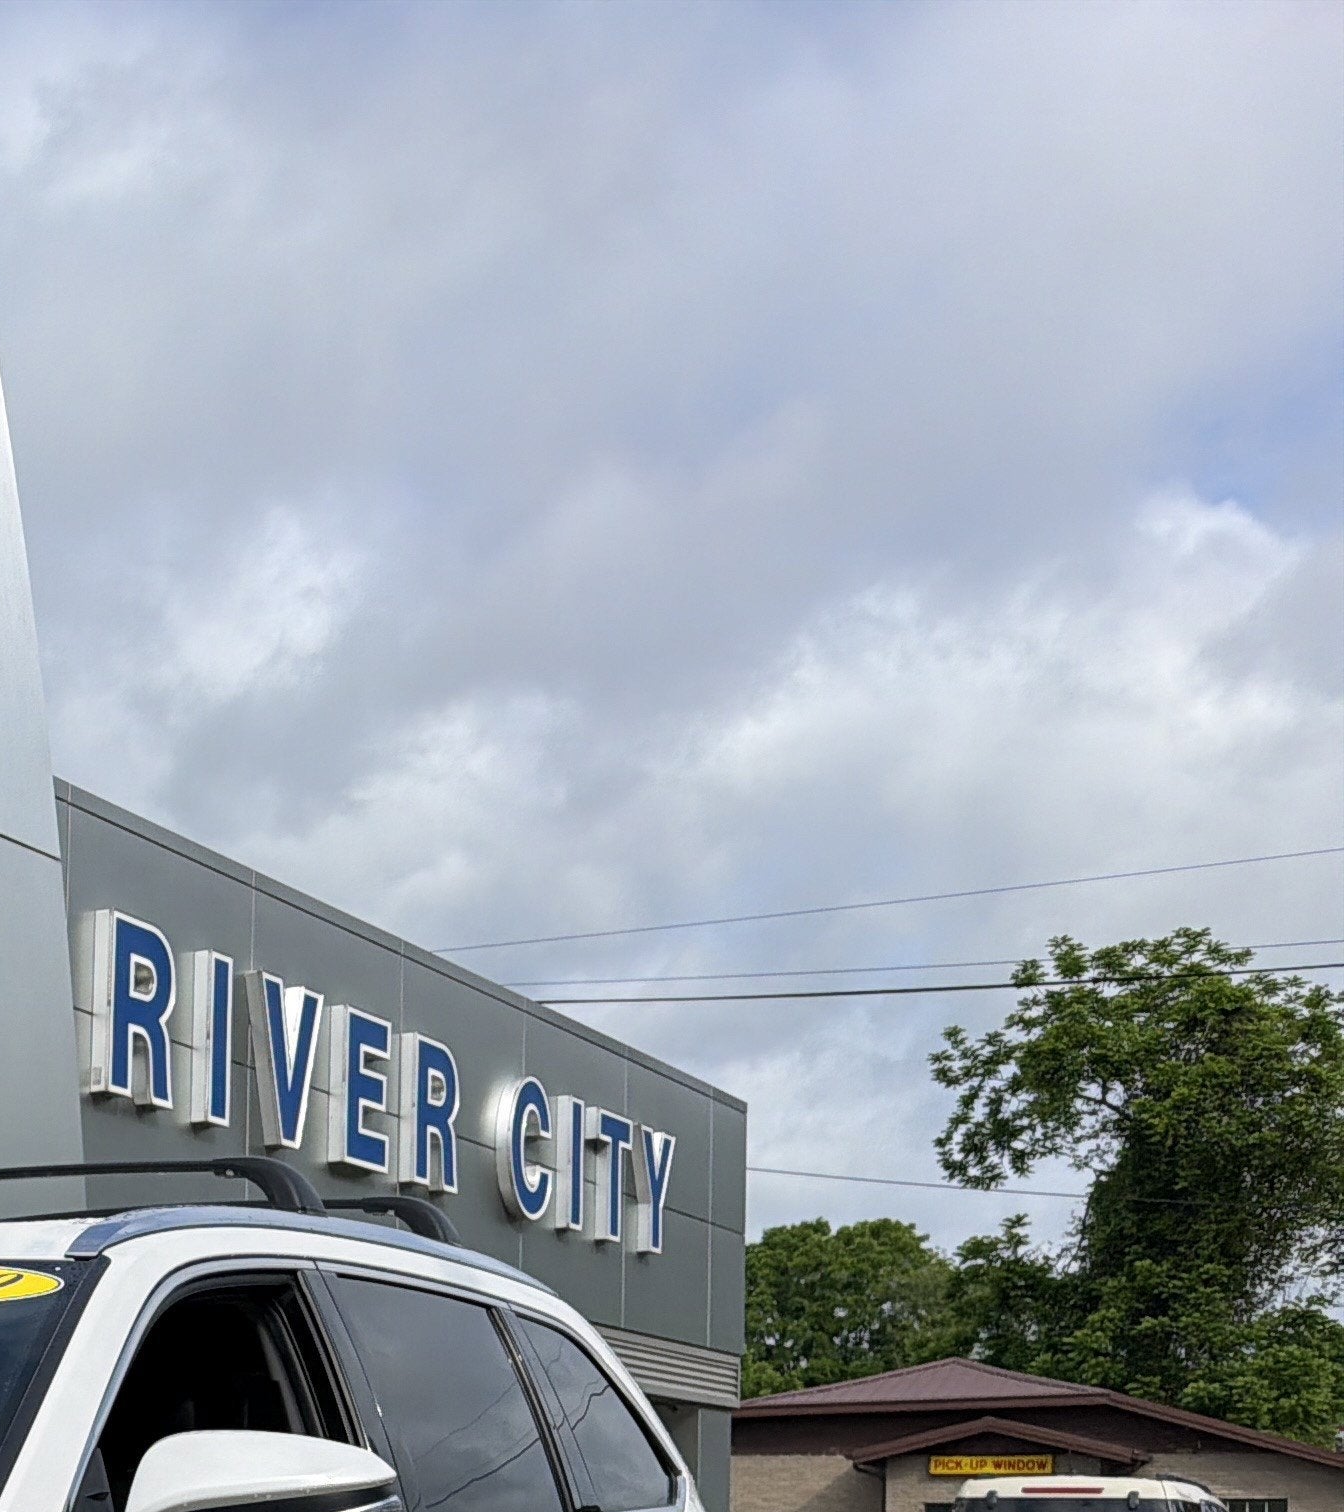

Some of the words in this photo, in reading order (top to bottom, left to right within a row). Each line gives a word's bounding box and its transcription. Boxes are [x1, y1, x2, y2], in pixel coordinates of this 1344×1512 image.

[90, 908, 459, 1194] RIVER
[495, 1076, 676, 1255] CITY
[992, 1459, 1048, 1471] WINDOW
